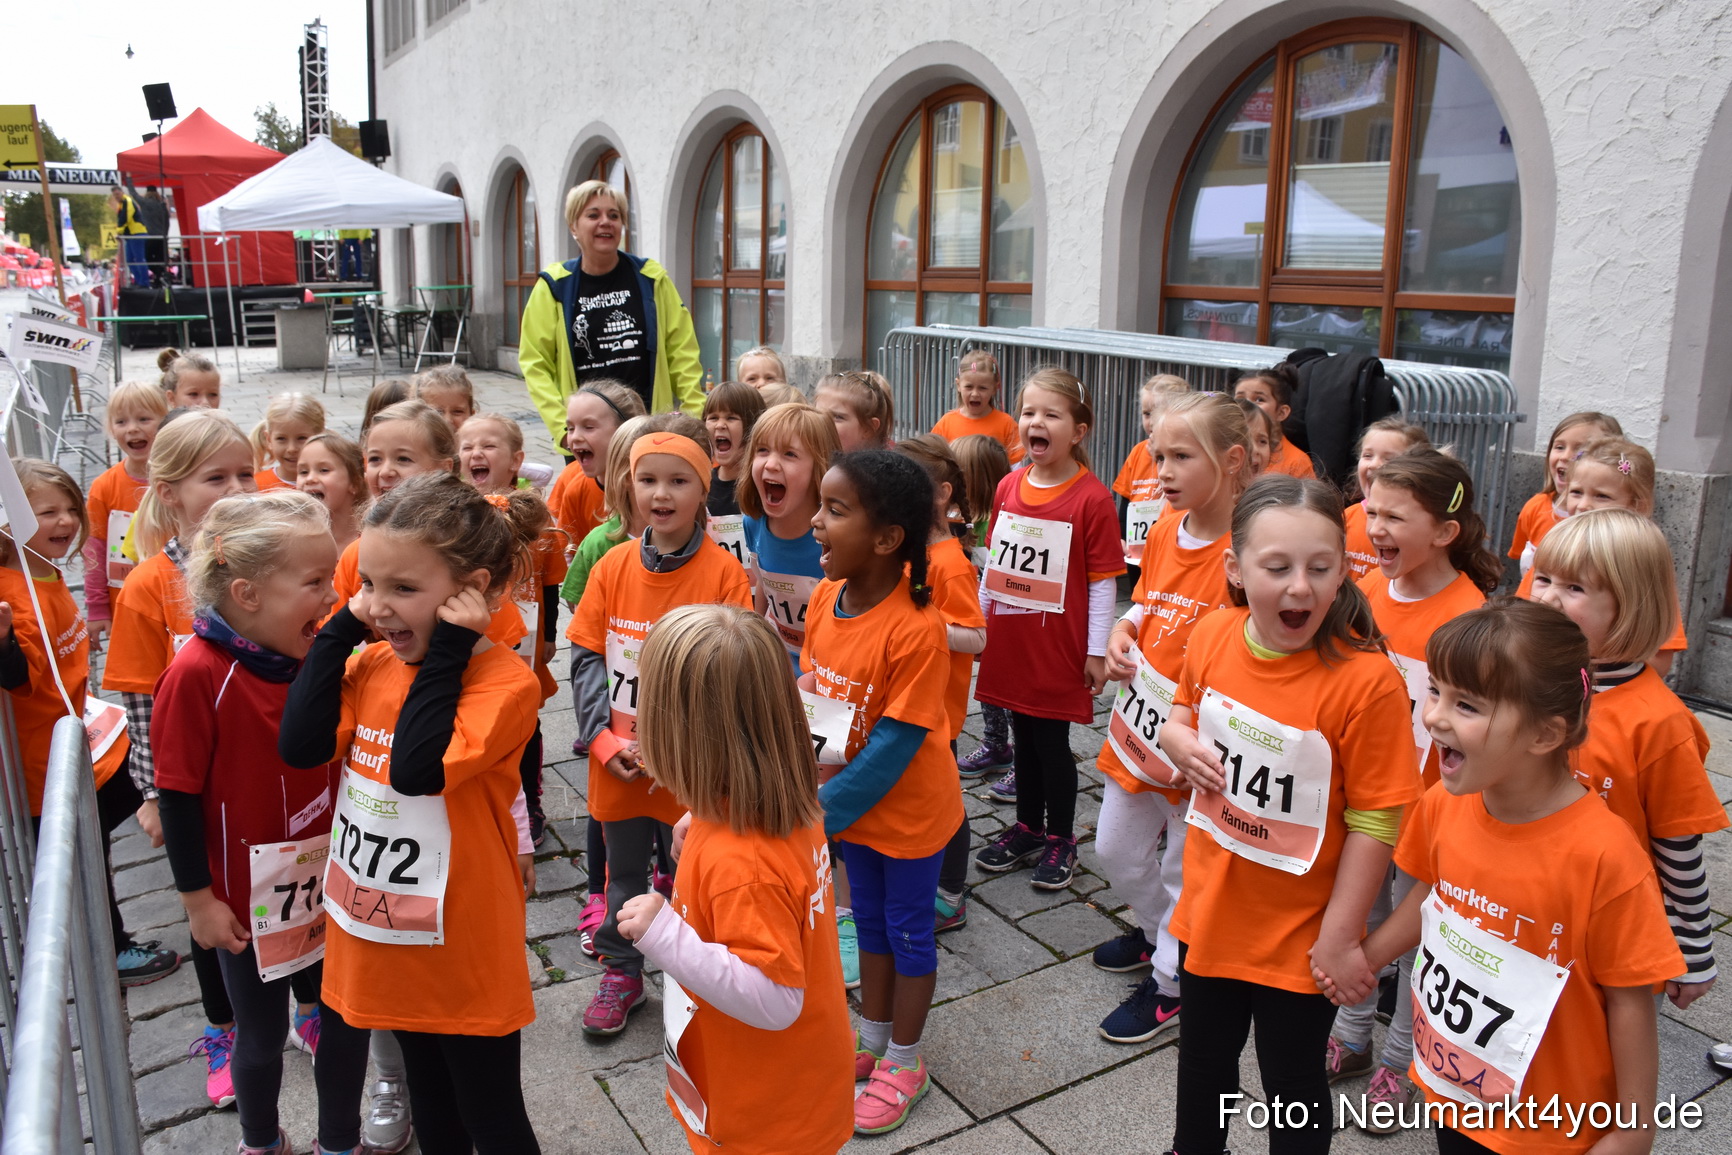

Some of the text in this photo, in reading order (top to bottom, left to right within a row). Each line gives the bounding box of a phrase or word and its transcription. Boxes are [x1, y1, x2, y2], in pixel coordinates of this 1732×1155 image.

[0, 123, 34, 135] ugend
[8, 134, 28, 145] lauf
[55, 169, 119, 185] NEUMA
[24, 330, 71, 348] swn
[1017, 524, 1043, 536] BOCK
[1133, 520, 1157, 541] 72
[998, 540, 1049, 575] 7121
[1006, 579, 1031, 593] Emma
[1125, 734, 1146, 763] Emma
[1239, 722, 1284, 752] BOCK
[1214, 739, 1294, 814] 7141
[302, 801, 323, 823] DEHN
[355, 790, 398, 815] BOCK
[1220, 805, 1269, 841] Hannah
[340, 813, 420, 885] 7272
[343, 879, 394, 928] LEA
[257, 920, 269, 931] B1
[1448, 929, 1504, 973] BOCK
[1419, 946, 1515, 1048] 7357
